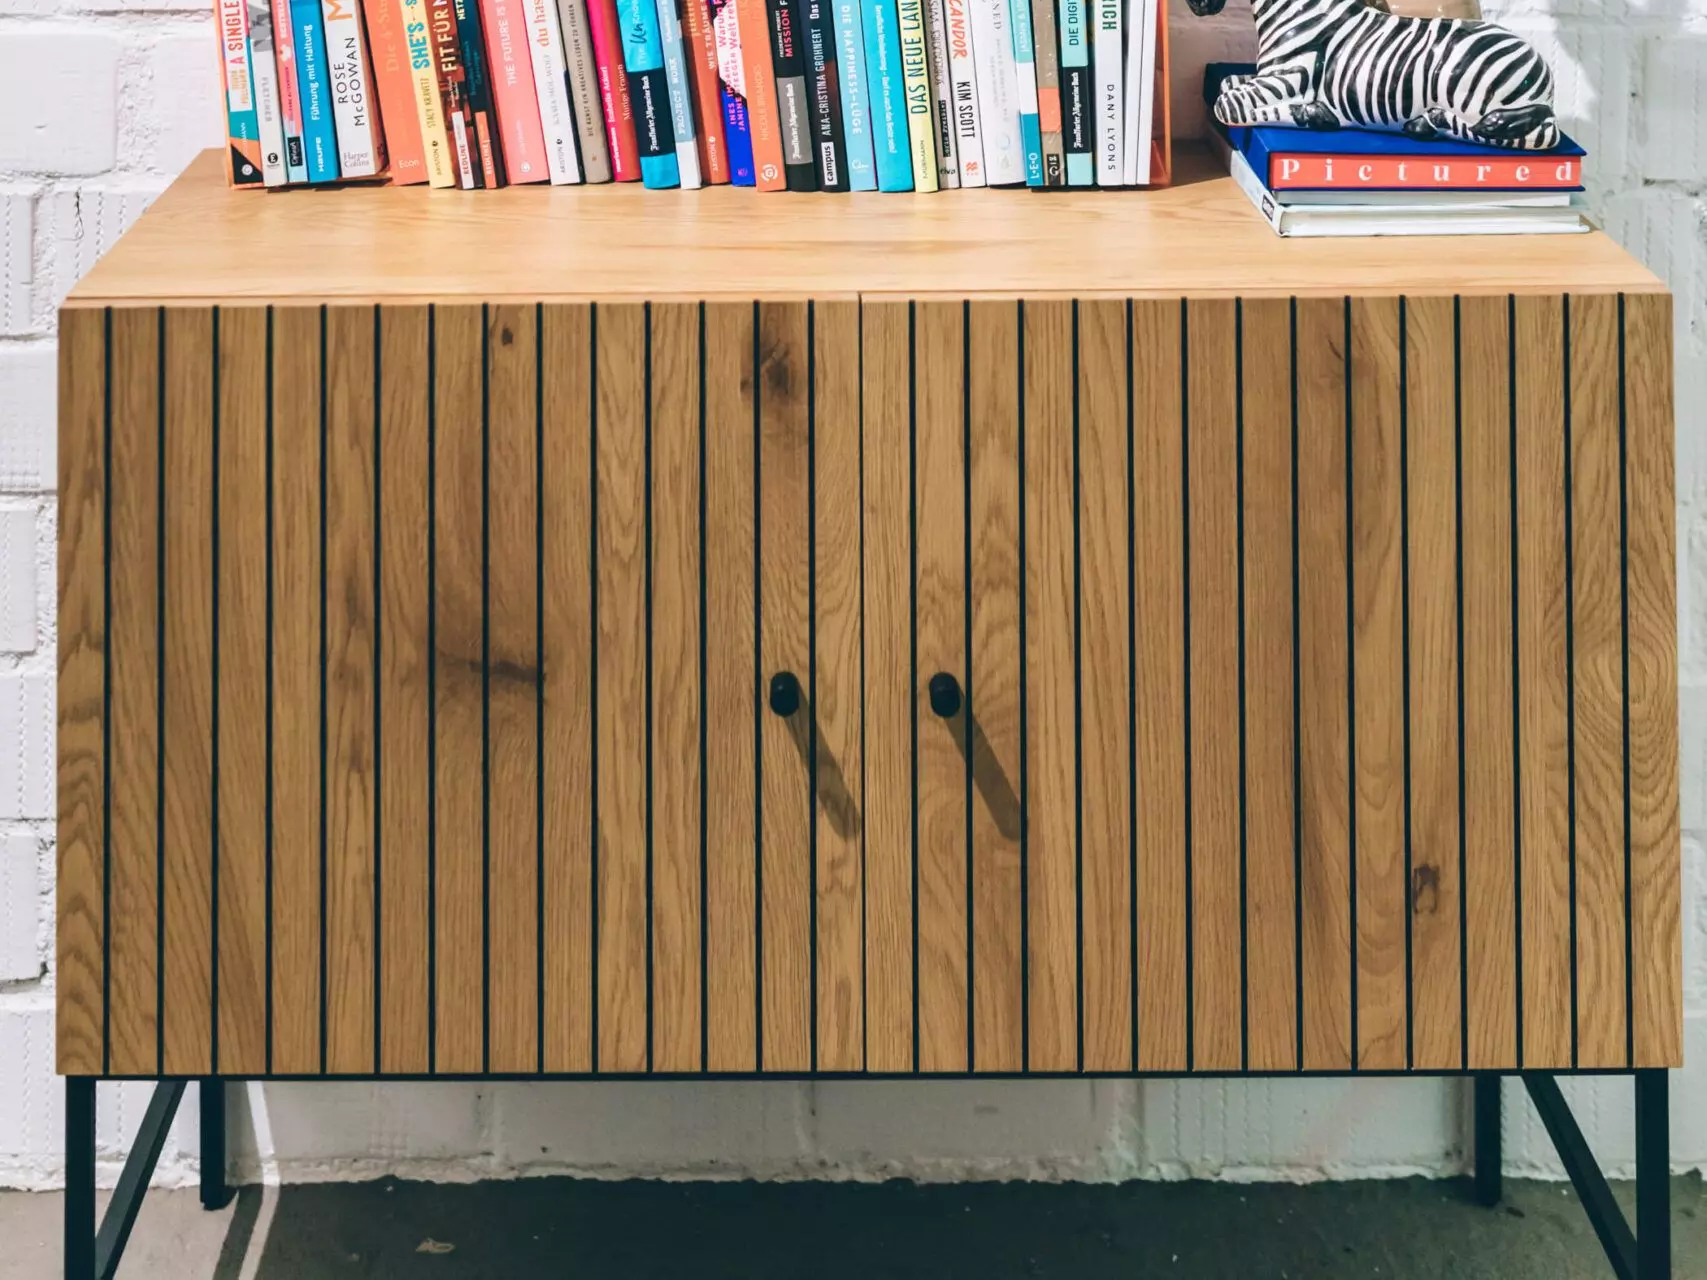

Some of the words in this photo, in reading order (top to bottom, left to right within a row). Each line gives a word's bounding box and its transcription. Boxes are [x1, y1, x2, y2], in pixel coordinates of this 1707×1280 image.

[224, 0, 244, 52] SINGLE
[434, 8, 453, 43] FÜR
[496, 5, 506, 16] IS
[810, 4, 820, 20] Das
[841, 4, 852, 24] DIE
[304, 24, 314, 61] Haltung
[499, 19, 513, 62] FUTURE
[536, 27, 550, 48] du
[699, 6, 713, 48] TRÄUME
[716, 6, 727, 48] Warum
[727, 24, 738, 49] Welt
[781, 8, 793, 58] MISSION
[1068, 27, 1079, 46] DIE
[230, 56, 245, 65] A
[386, 43, 400, 72] Die
[407, 21, 430, 70] SHE'S
[439, 46, 458, 73] FIT
[707, 51, 716, 70] WIE
[812, 28, 825, 72] GROHNERT
[904, 37, 924, 78] NEUE
[333, 63, 348, 104] ROSE
[344, 37, 365, 126] McGOWAN
[506, 64, 517, 88] THE
[617, 64, 629, 92] Frauen
[641, 75, 650, 90] Buch
[669, 57, 679, 84] WORK
[844, 28, 862, 134] HAPPINESS-LÜGE
[311, 81, 320, 120] Führung
[420, 77, 433, 106] KRAVETZ
[645, 88, 655, 119] Allgemeine
[786, 83, 794, 97] Buch
[816, 74, 831, 136] ANA-CRISTINA
[908, 84, 928, 115] DAS
[957, 81, 971, 101] KIM
[1072, 85, 1082, 116] Allgemeine
[1106, 84, 1115, 120] DANY
[425, 109, 436, 129] STACY
[604, 90, 615, 123] Isabella
[620, 94, 632, 120] Mutige
[673, 90, 685, 135] PROJECT
[728, 103, 736, 124] INES
[736, 96, 746, 131] JANINE
[788, 97, 798, 128] Allgemeine
[958, 105, 975, 138] SCOTT
[648, 118, 659, 152] Frankfurter
[791, 127, 801, 160] Frankfurter
[1074, 116, 1083, 148] Frankfurter
[344, 152, 368, 162] Harper
[398, 158, 419, 169] Econ
[460, 144, 469, 174] REDLINE
[483, 143, 492, 174] REDLINE
[556, 146, 566, 173] ARISTON
[1107, 127, 1116, 170] LYONS
[1281, 158, 1572, 181] Pictured
